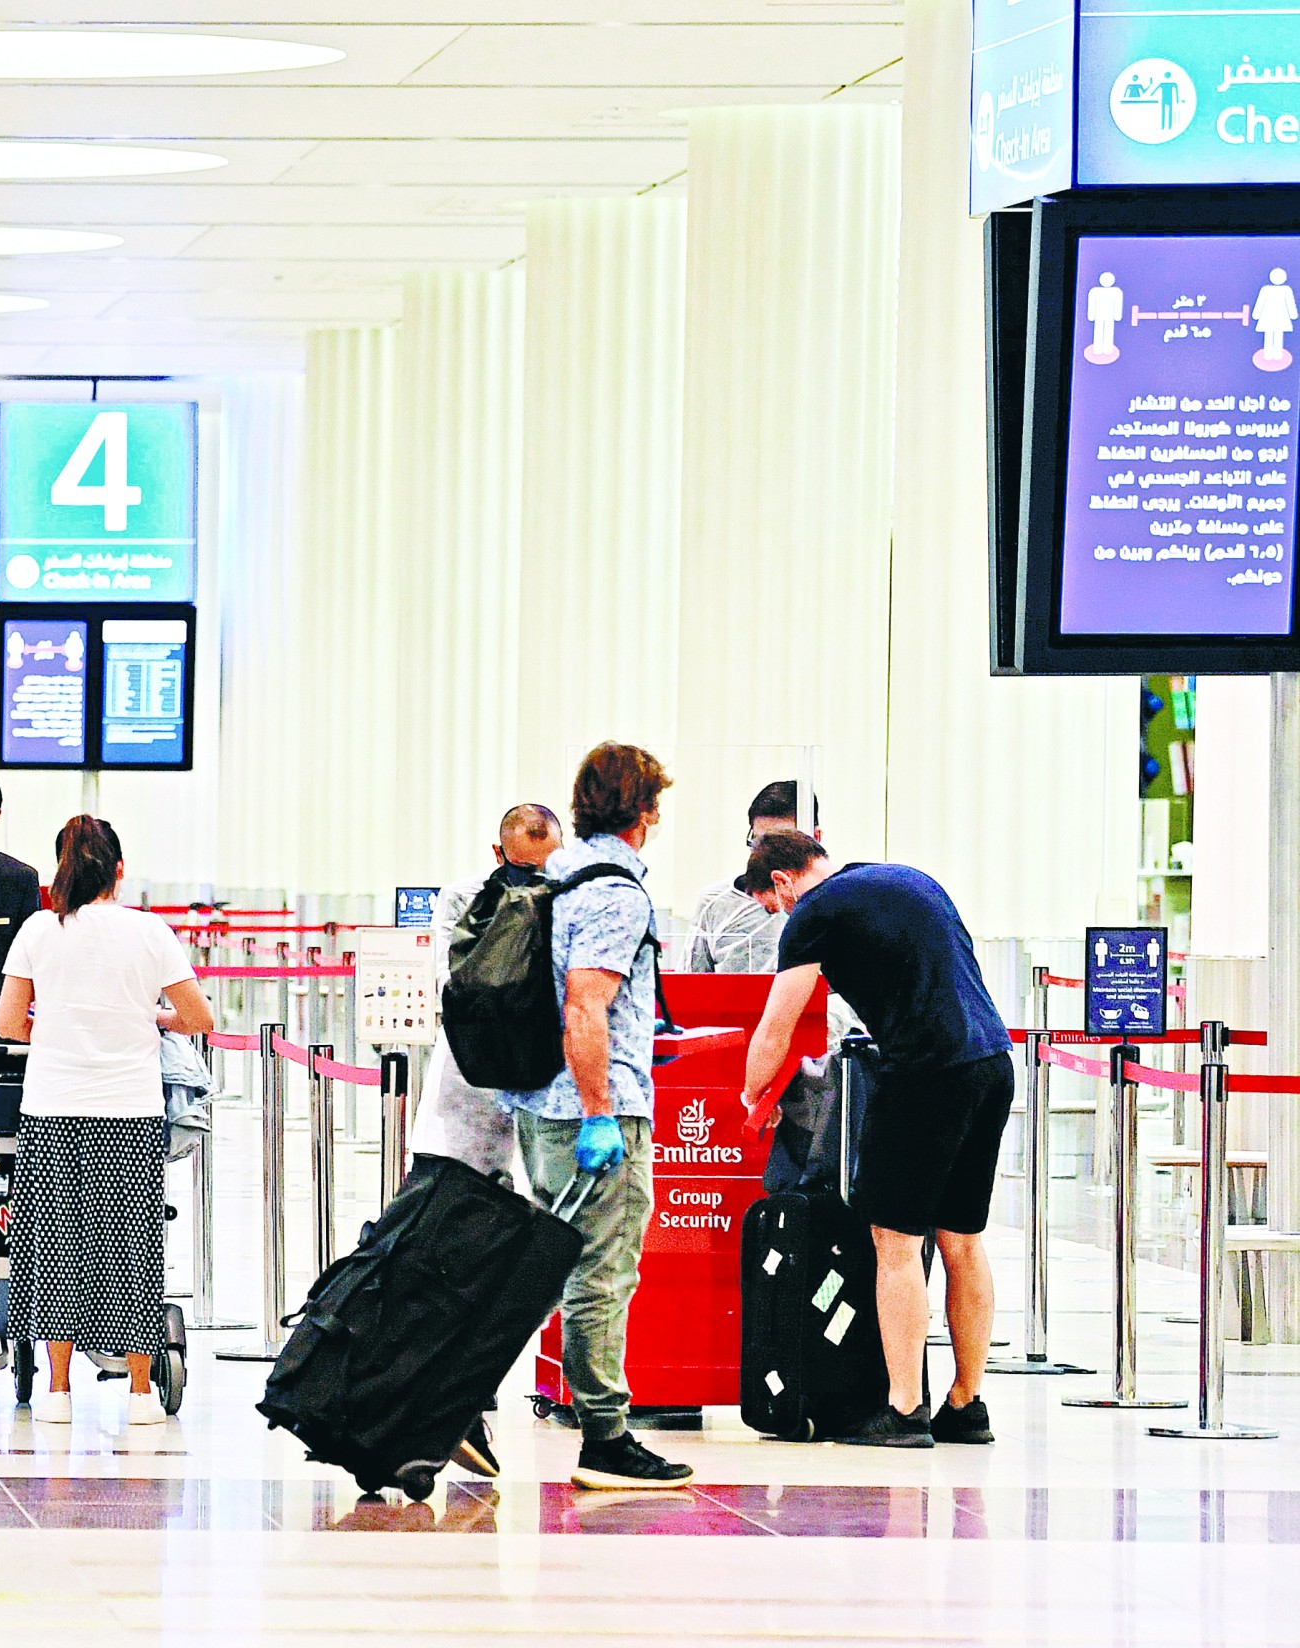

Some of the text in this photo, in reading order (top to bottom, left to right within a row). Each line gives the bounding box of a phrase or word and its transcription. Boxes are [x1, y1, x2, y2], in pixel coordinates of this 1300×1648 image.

[1216, 103, 1300, 144] Che
[1030, 122, 1051, 157] Area
[1179, 396, 1202, 412] من
[1205, 395, 1235, 411] الحد
[1269, 395, 1291, 411] من
[1184, 420, 1231, 438] كورونا
[1235, 421, 1290, 438] فيروس
[1097, 445, 1288, 463] نرجو من المسافرين الحفاظ
[51, 411, 142, 532] 4
[1203, 470, 1252, 487] التباعد
[1255, 470, 1287, 486] على
[1089, 495, 1139, 509] الحفاظ
[1246, 497, 1286, 512] جميع
[1149, 519, 1284, 536] على مسافة مترين
[1093, 545, 1116, 560] من
[1119, 545, 1153, 561] وبين
[1155, 544, 1200, 562] بينكم
[1119, 943, 1136, 953] 2m
[652, 1143, 743, 1164] Emirates
[668, 1188, 723, 1210] Group
[659, 1211, 732, 1232] Security
